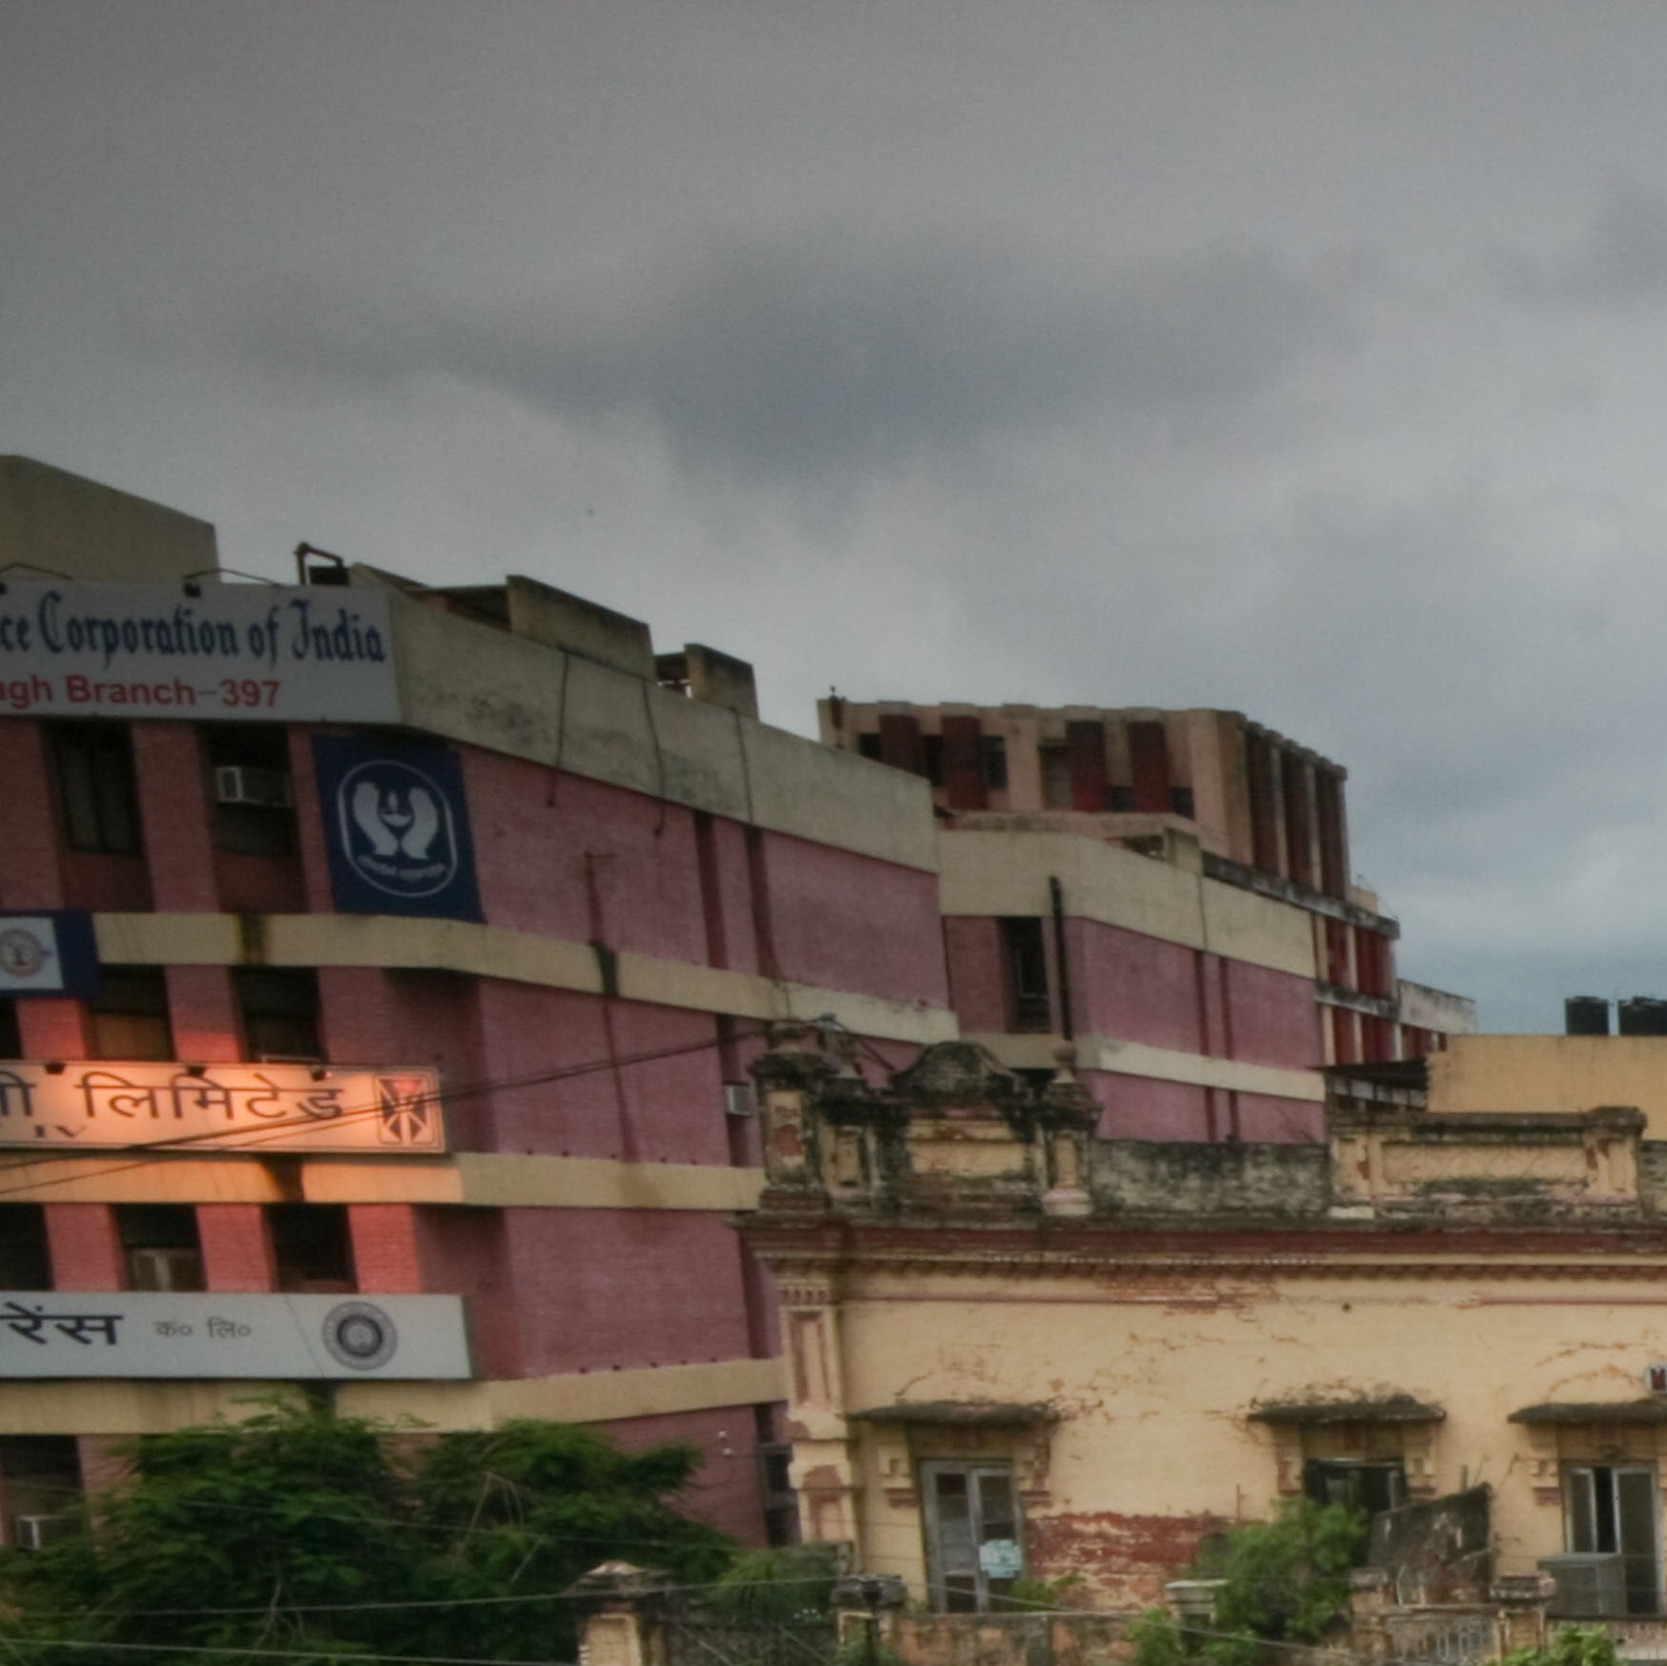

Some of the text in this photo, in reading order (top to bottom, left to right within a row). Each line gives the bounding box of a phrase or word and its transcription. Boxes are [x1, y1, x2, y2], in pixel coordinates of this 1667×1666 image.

[39, 591, 240, 669] Corporation
[249, 606, 281, 671] of
[290, 597, 386, 662] India
[74, 1071, 342, 1120] लिमिटेड
